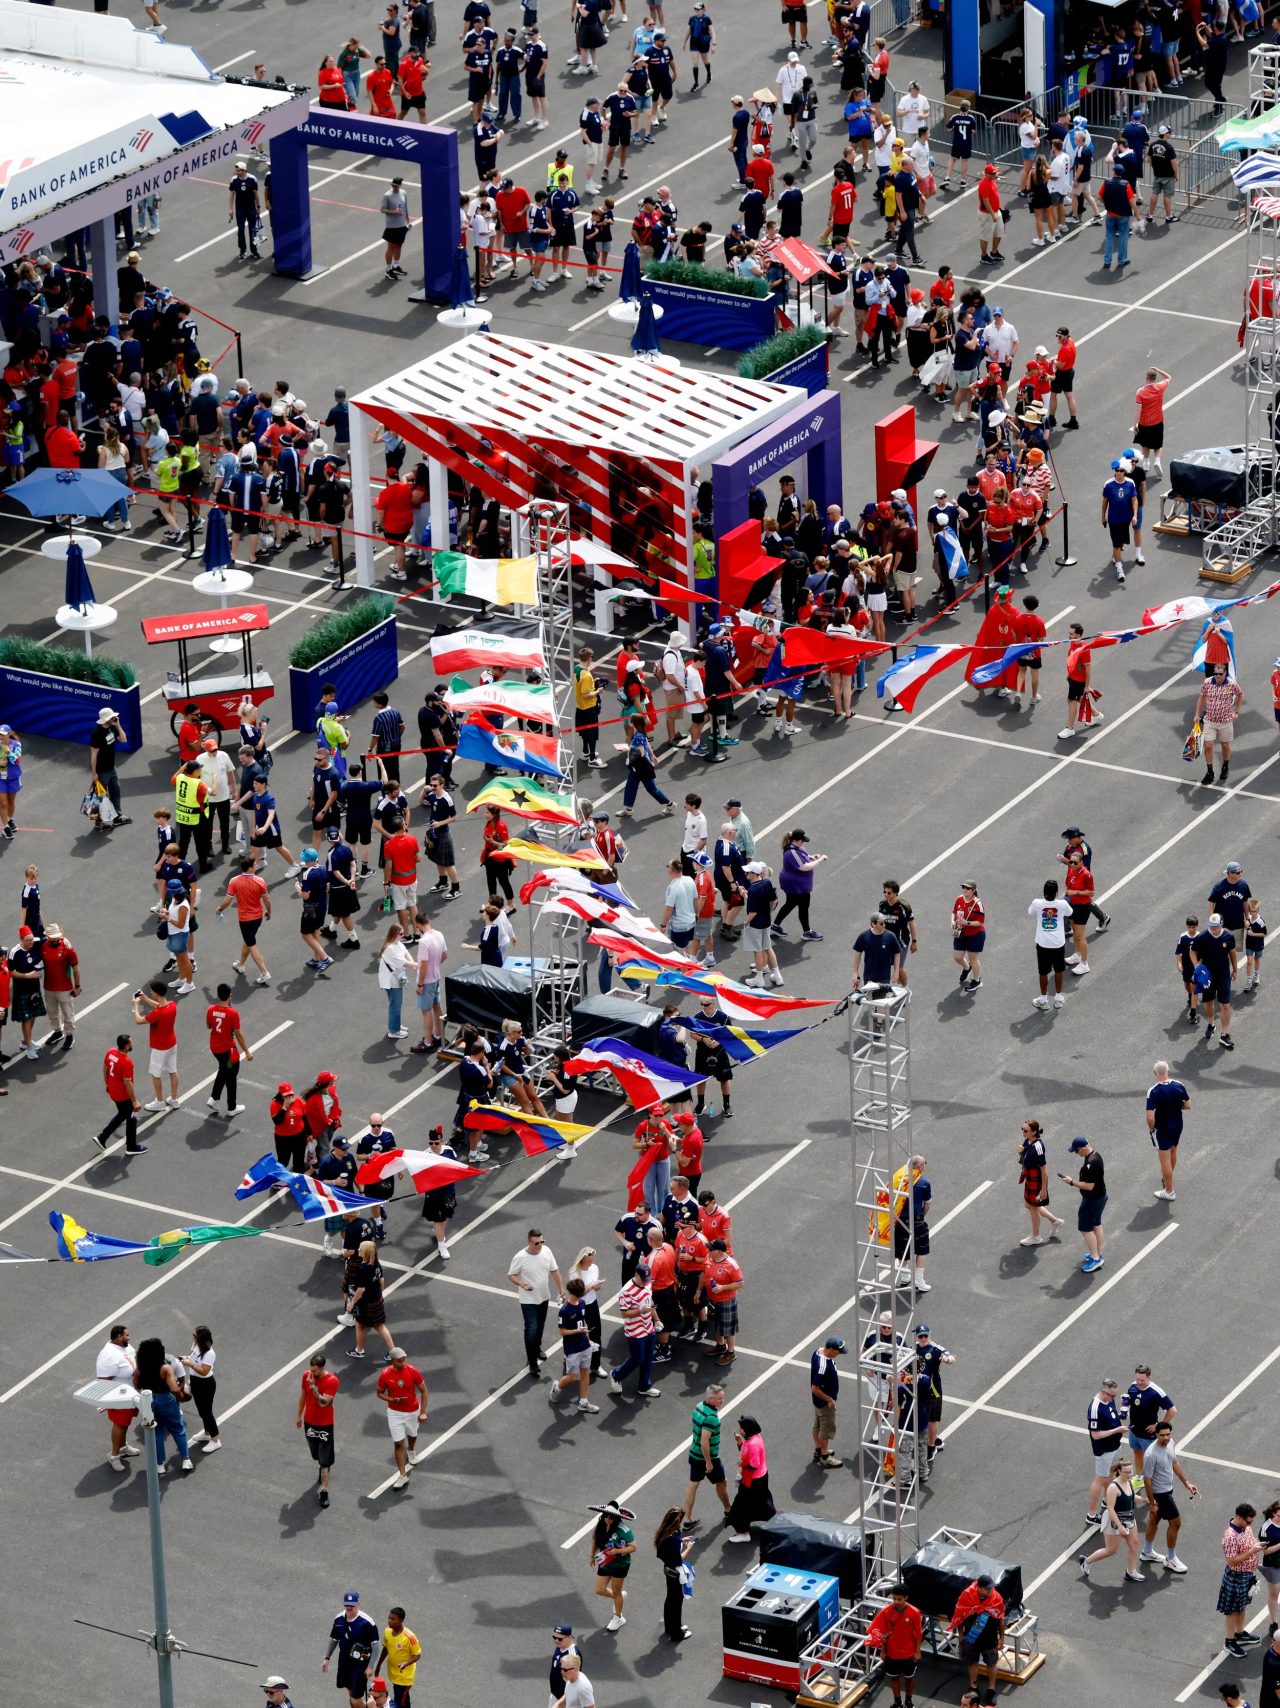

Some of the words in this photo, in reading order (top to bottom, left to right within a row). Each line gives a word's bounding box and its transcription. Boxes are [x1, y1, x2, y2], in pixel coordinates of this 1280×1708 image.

[296, 122, 326, 136] BANK
[328, 128, 342, 138] OF
[344, 131, 394, 148] AMERICA
[958, 125, 966, 140] 4
[11, 182, 47, 210] BANK
[50, 173, 66, 192] OF
[70, 148, 127, 186] AMERICA
[126, 174, 161, 203] BANK
[164, 165, 180, 185] OF
[182, 140, 239, 176] AMERICA
[844, 193, 852, 210] 11
[655, 286, 669, 296] What
[670, 290, 686, 298] would
[687, 292, 696, 300] you
[717, 299, 733, 307] power
[748, 455, 768, 475] BANK
[768, 448, 778, 462] OF
[778, 428, 810, 456] AMERICA
[155, 623, 182, 634] BANK
[182, 622, 194, 630] OF
[196, 618, 238, 628] AMERICA
[318, 665, 329, 676] What
[329, 657, 341, 670] would
[348, 648, 356, 658] like
[362, 636, 374, 650] power
[6, 674, 22, 682] What
[22, 678, 40, 686] would
[40, 681, 52, 689] you
[74, 688, 92, 697] power
[1222, 890, 1244, 900] SCOTLAND
[216, 1018, 222, 1032] 2
[109, 1061, 114, 1076] 2
